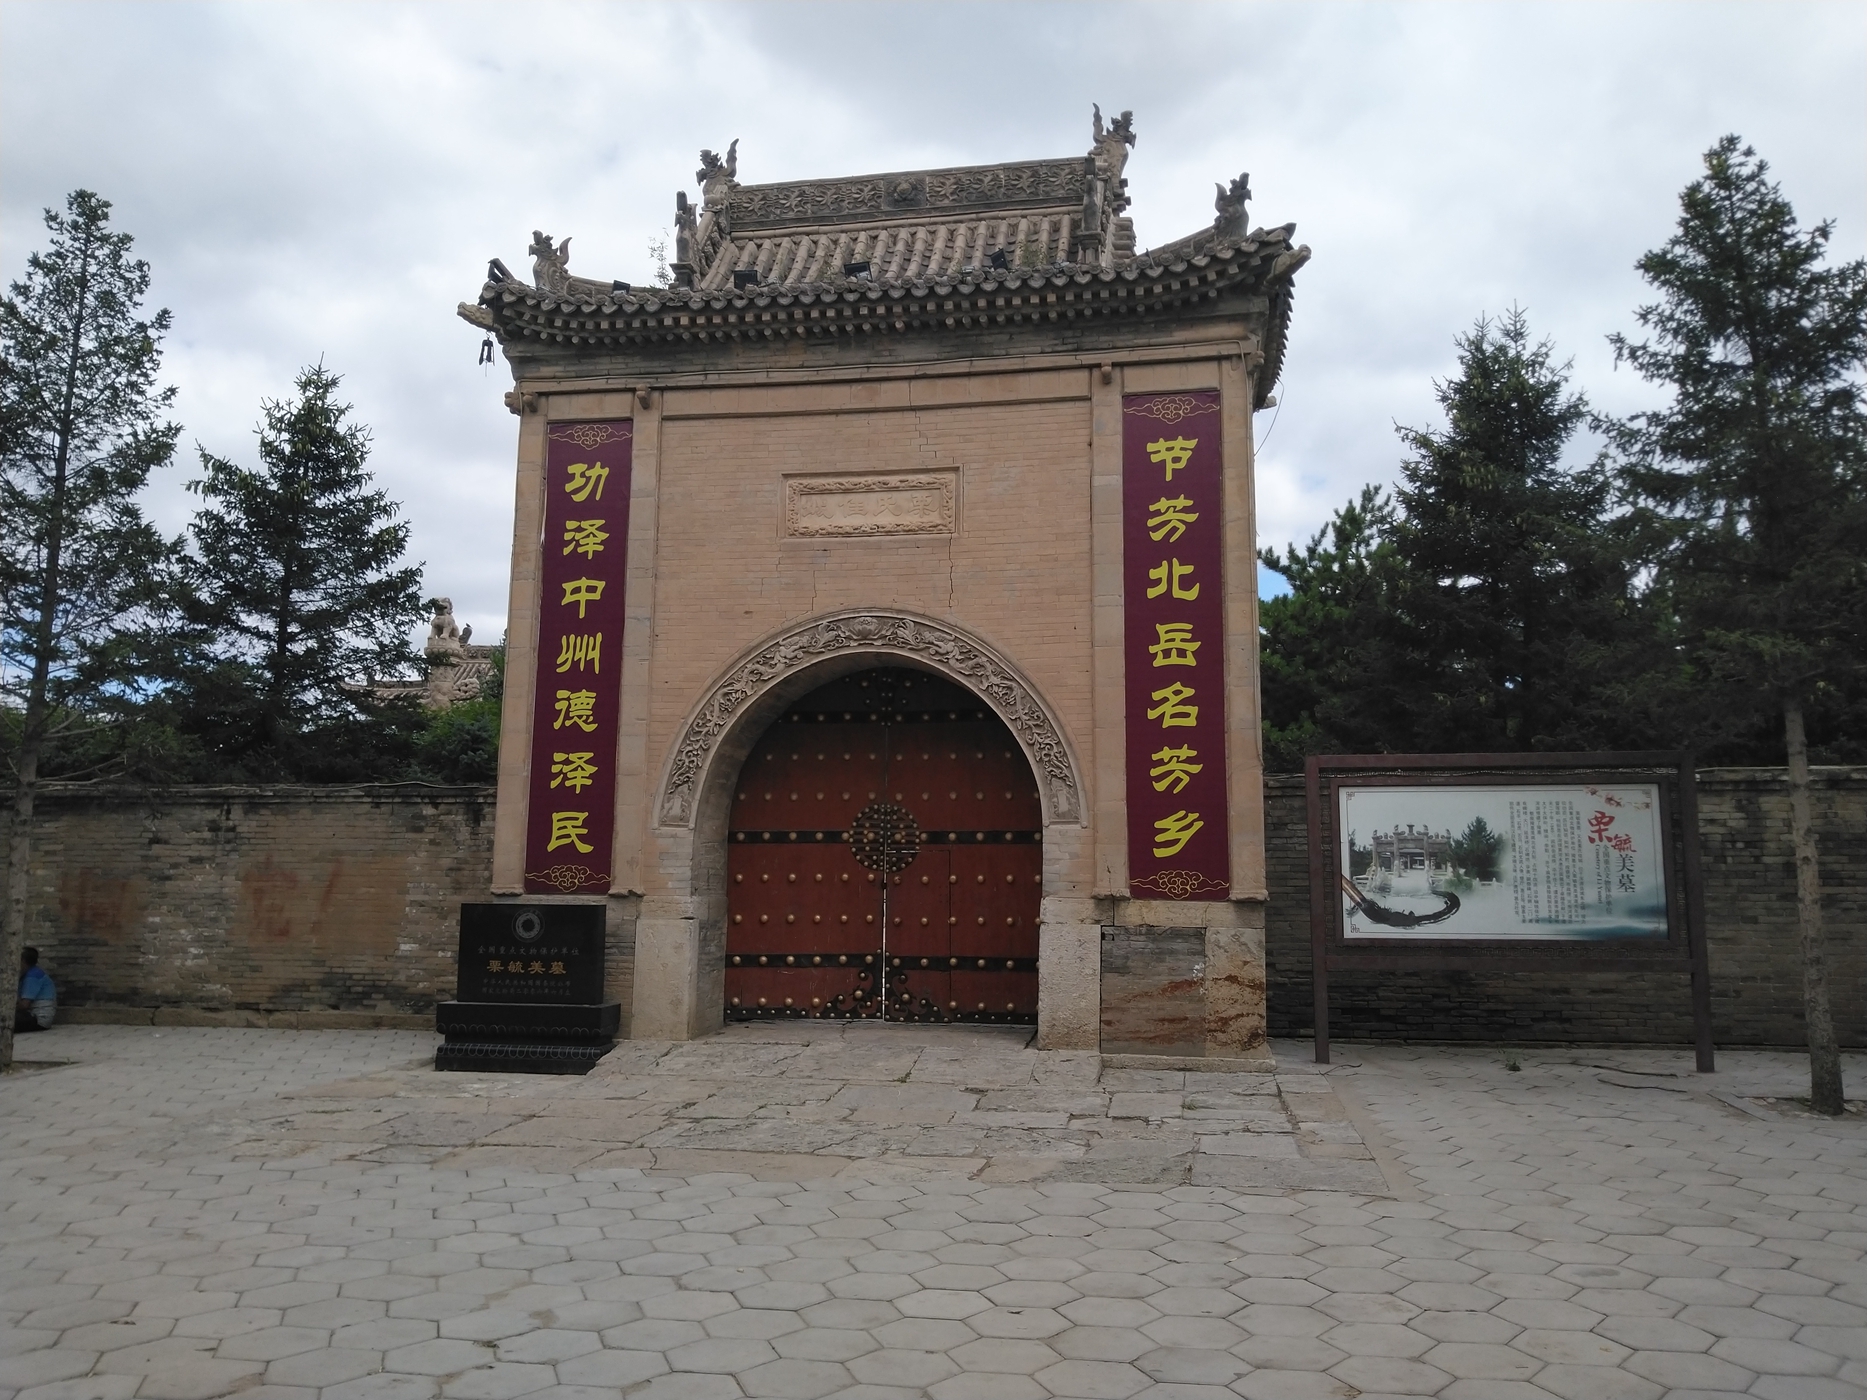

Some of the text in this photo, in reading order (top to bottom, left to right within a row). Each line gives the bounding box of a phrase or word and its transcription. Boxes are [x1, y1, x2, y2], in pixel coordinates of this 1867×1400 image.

[547, 461, 610, 853] 功泽中州德泽民
[1146, 435, 1204, 858] 节芳北岳名芳乡
[486, 960, 567, 975] 栗毓美墓
[1588, 810, 1637, 893] 栗毓美墓
